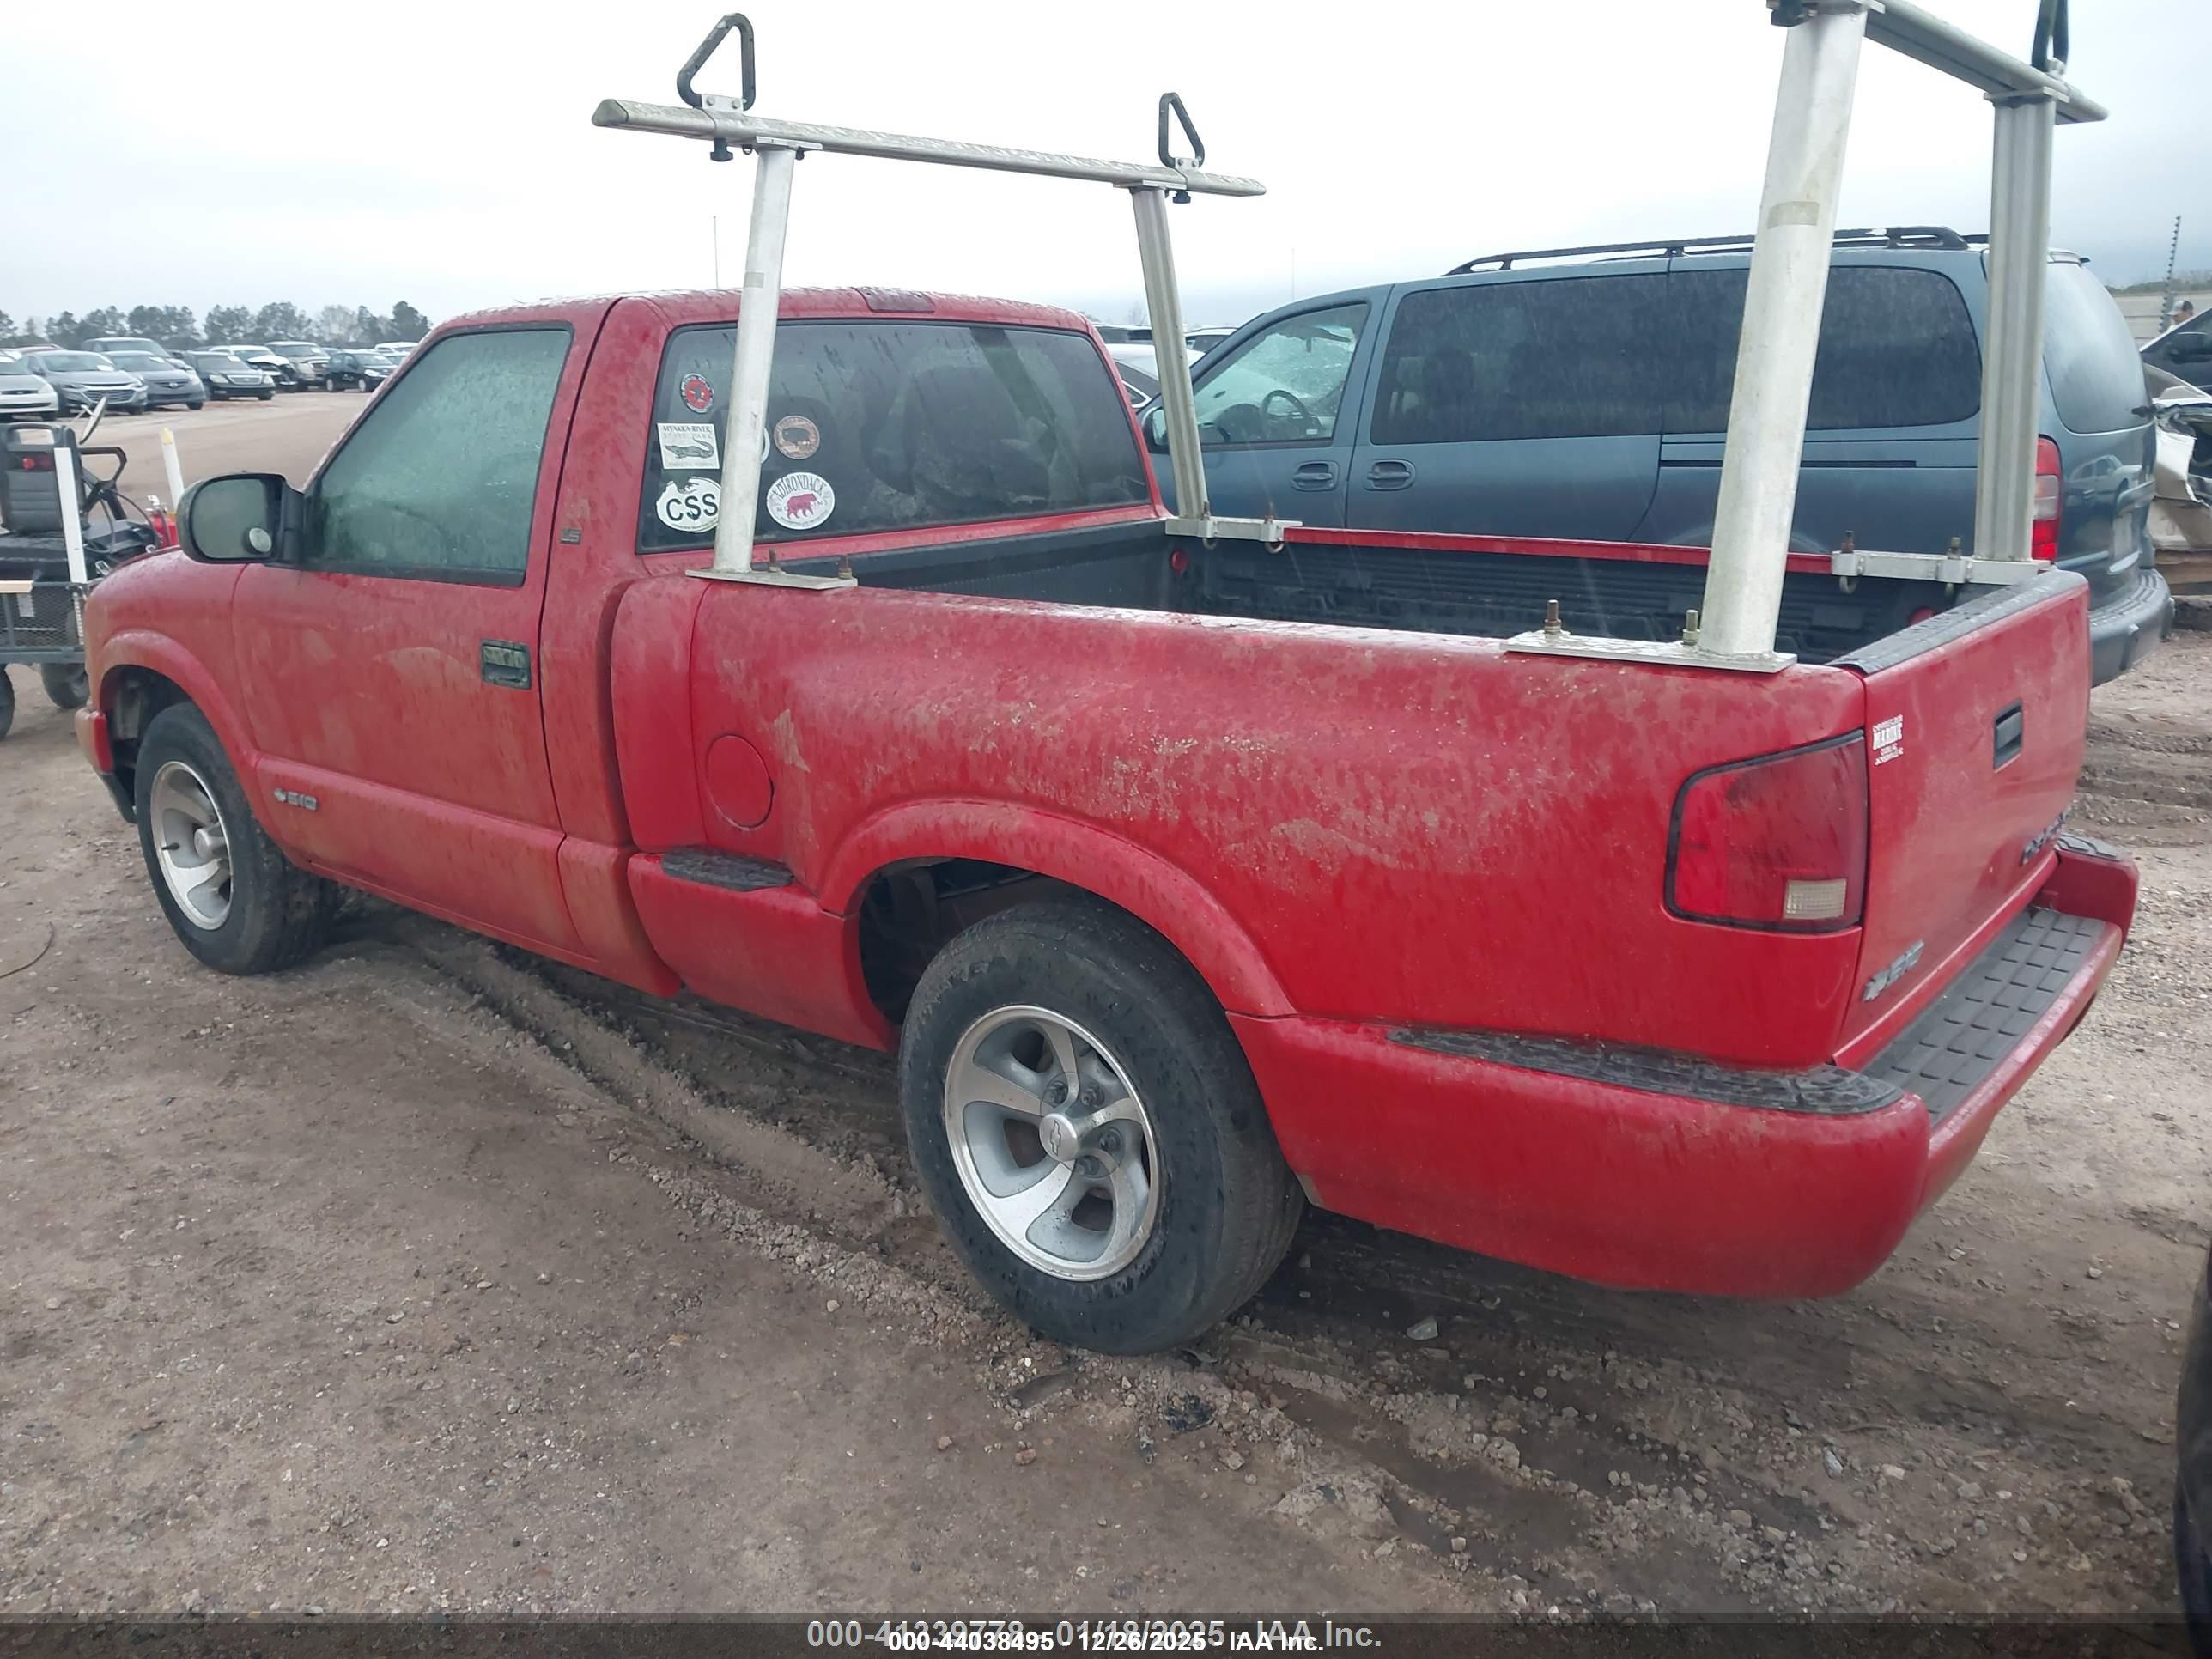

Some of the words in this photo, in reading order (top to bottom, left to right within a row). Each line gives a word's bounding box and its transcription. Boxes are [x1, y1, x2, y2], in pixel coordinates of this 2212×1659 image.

[772, 474, 827, 501] ADIRONDACK
[666, 493, 718, 522] CSS
[288, 791, 317, 811] S10
